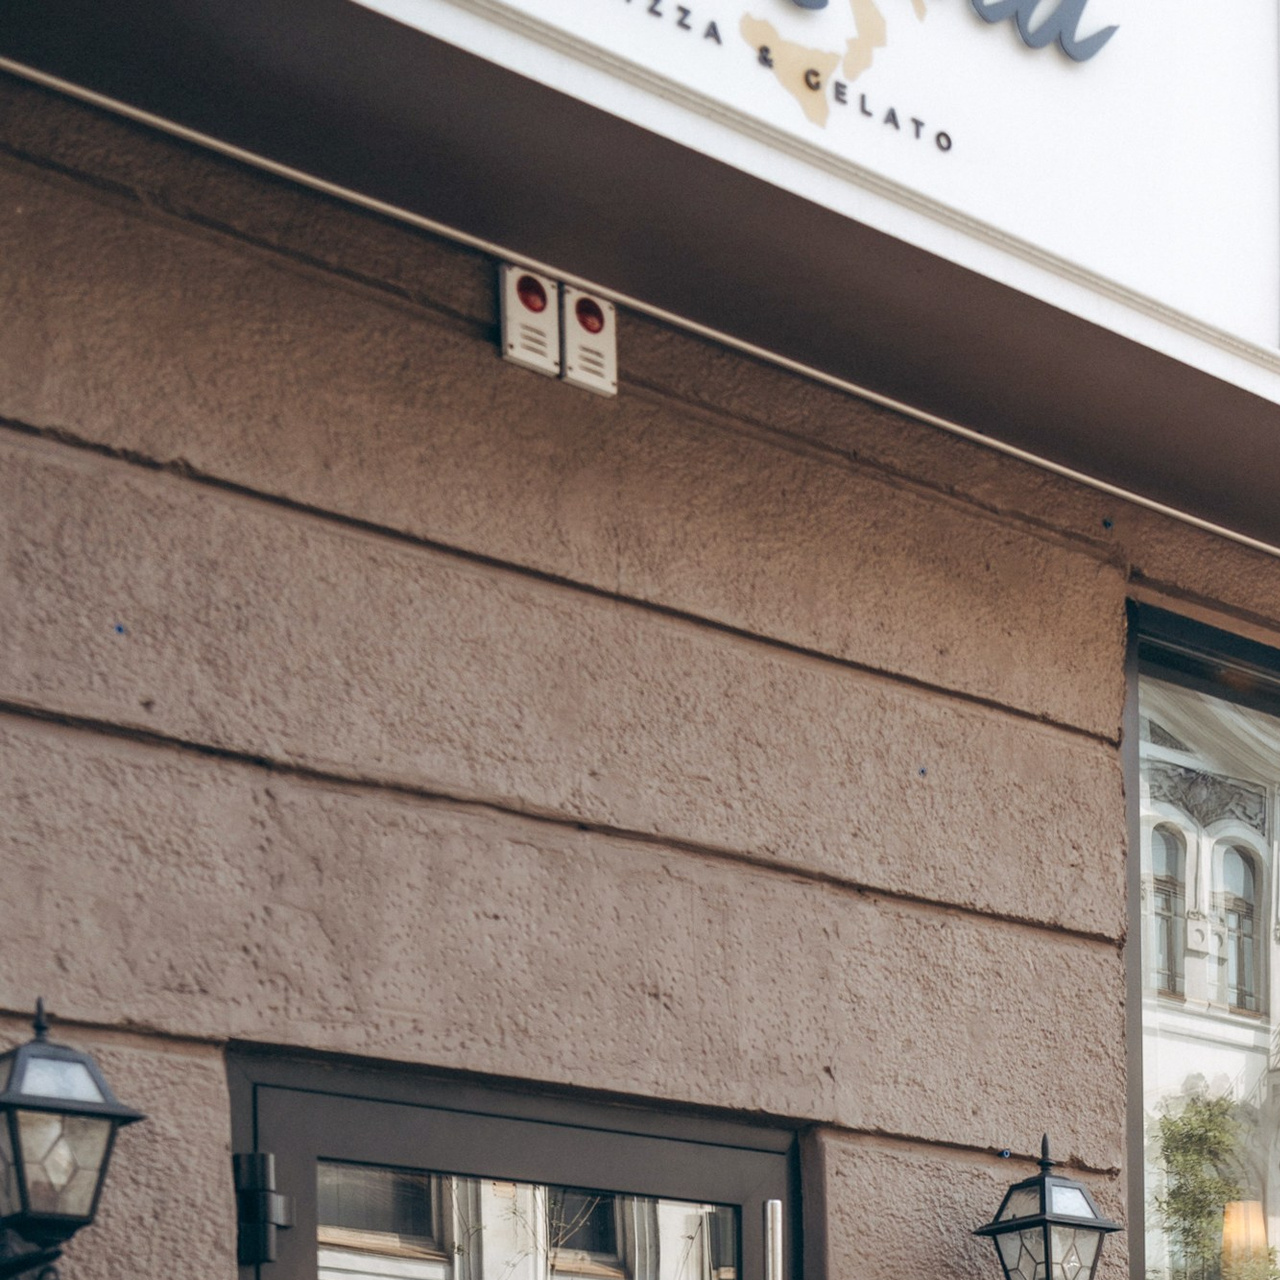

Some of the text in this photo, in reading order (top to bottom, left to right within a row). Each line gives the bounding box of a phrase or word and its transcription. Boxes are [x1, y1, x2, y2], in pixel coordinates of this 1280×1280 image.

[625, 0, 954, 153] ZZA & GELATO
